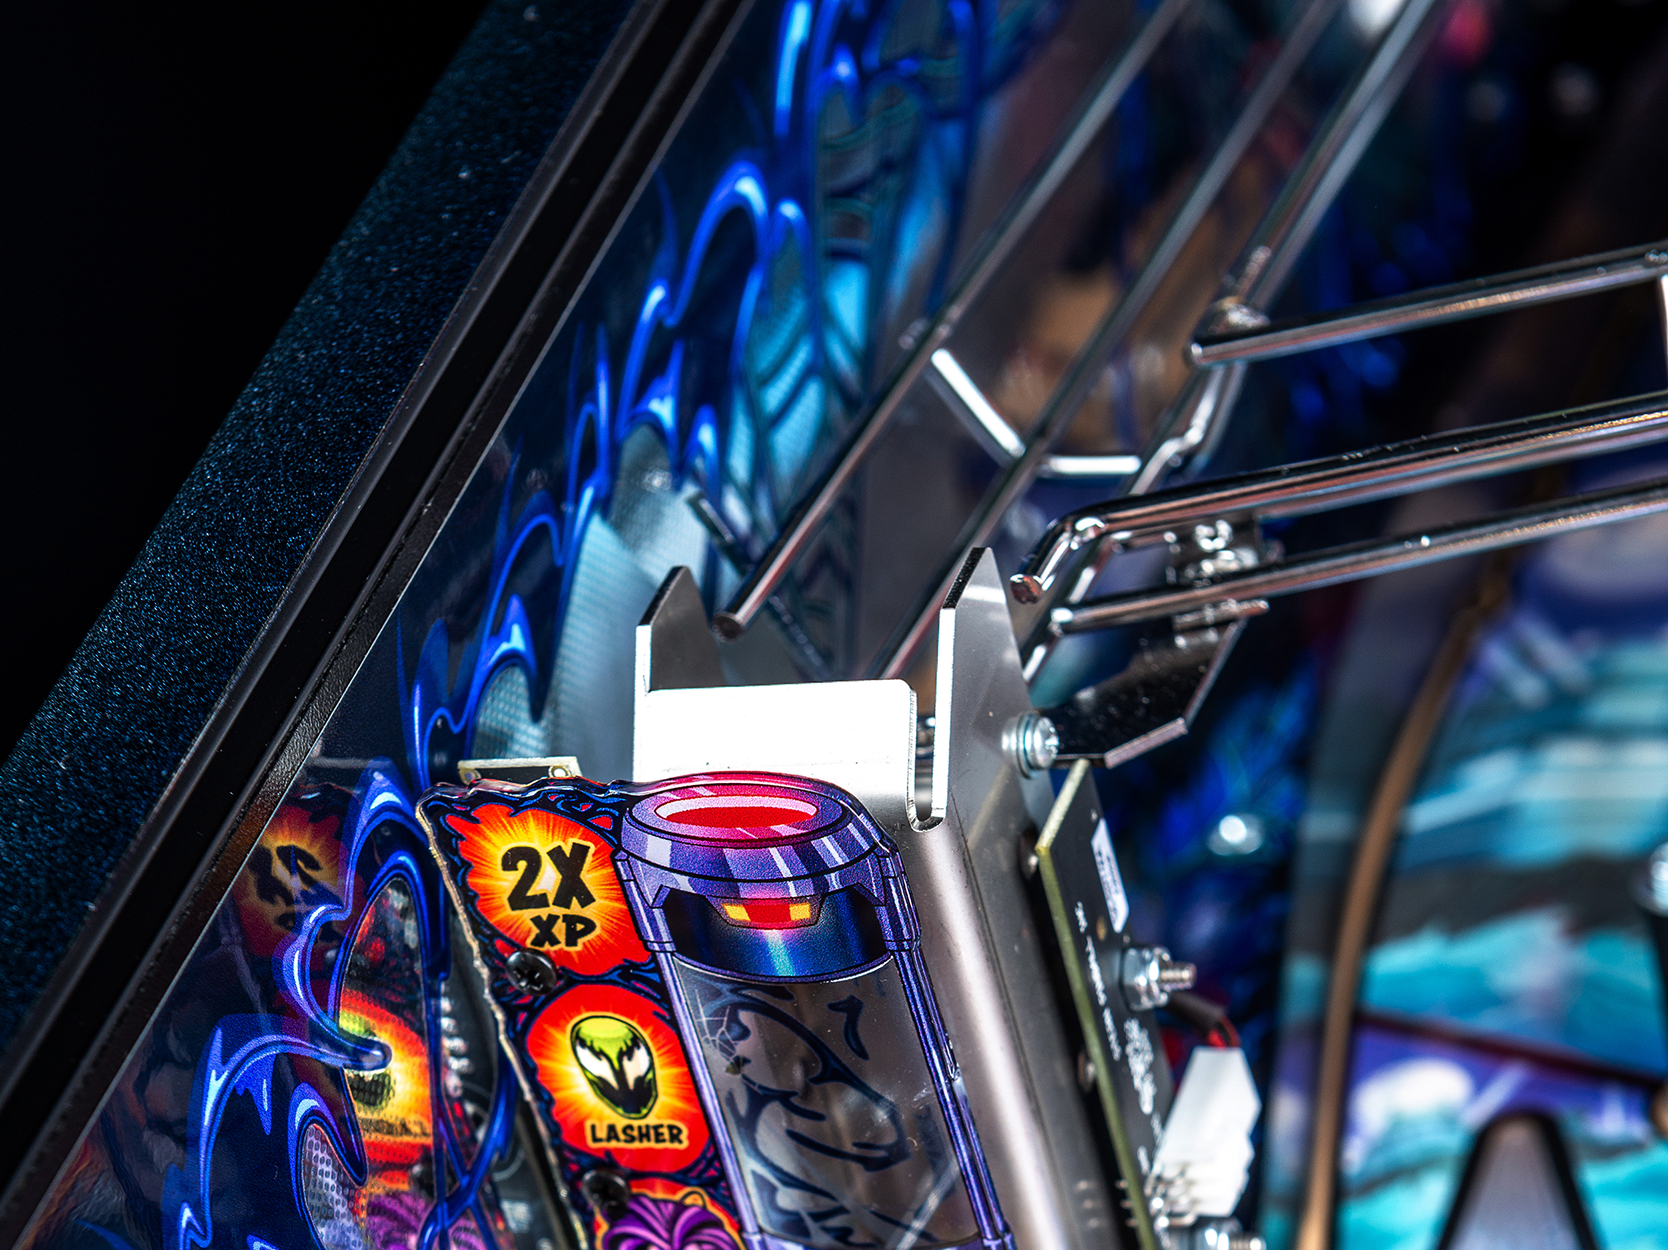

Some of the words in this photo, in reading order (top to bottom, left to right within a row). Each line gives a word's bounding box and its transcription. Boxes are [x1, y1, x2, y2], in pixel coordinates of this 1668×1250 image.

[501, 842, 597, 911] 2X
[530, 913, 597, 948] XP
[590, 1123, 683, 1145] LASHER
